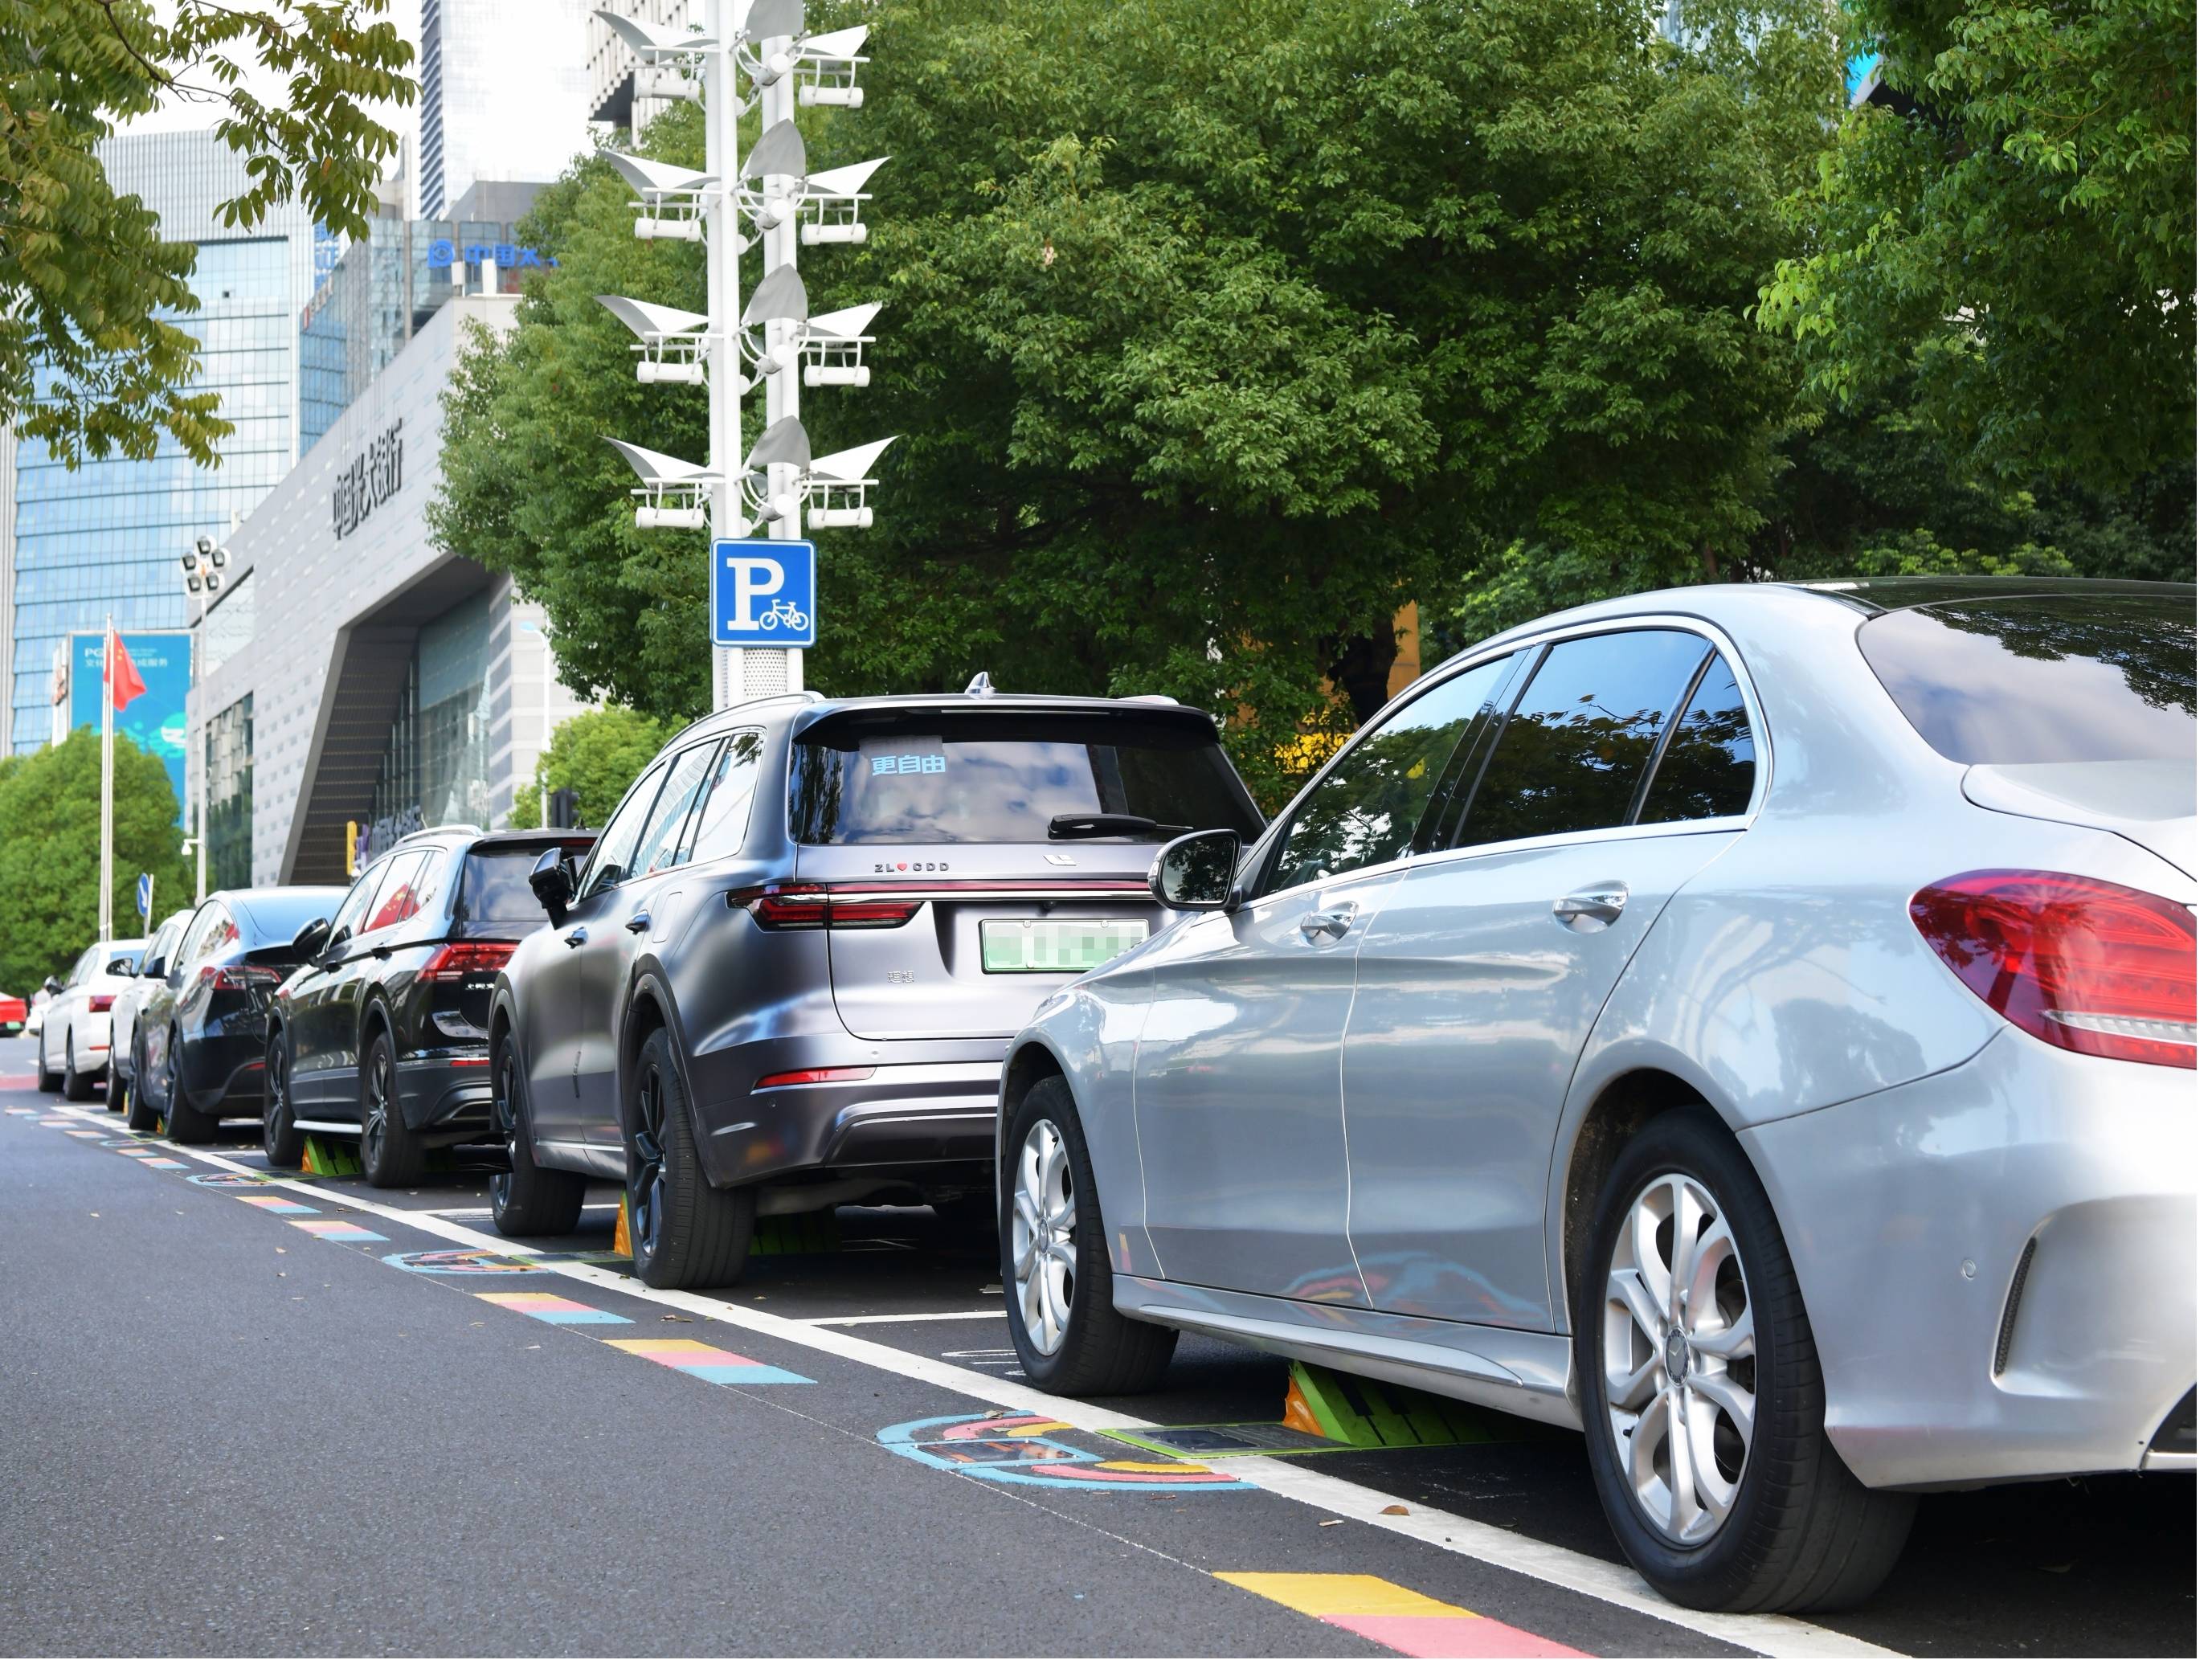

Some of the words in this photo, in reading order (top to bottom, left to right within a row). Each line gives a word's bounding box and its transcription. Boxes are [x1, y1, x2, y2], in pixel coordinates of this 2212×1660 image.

[333, 418, 403, 540] 中国光大银行
[726, 558, 785, 631] P
[871, 754, 946, 776] 更自由
[887, 970, 914, 984] 理想
